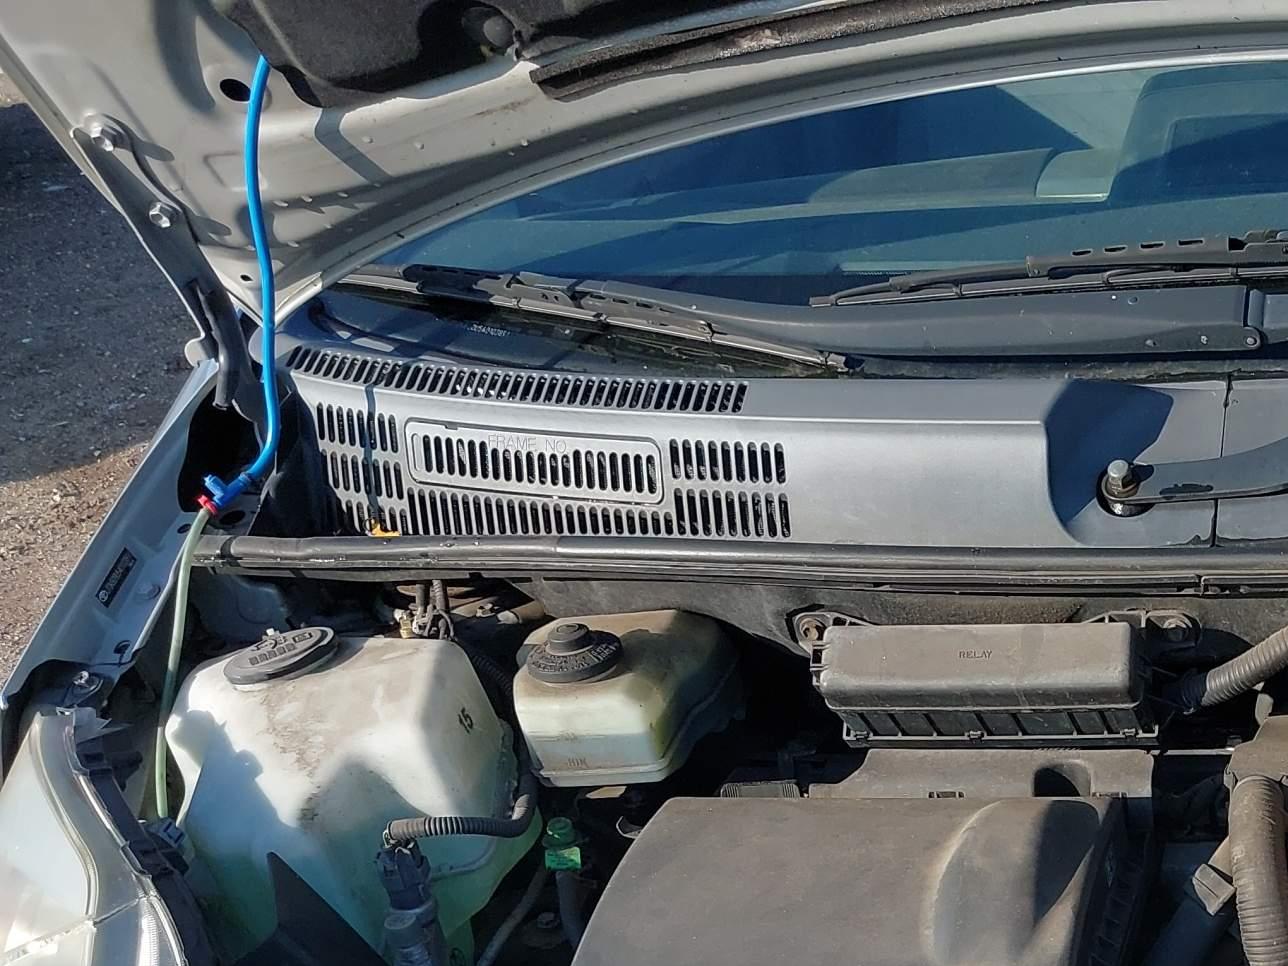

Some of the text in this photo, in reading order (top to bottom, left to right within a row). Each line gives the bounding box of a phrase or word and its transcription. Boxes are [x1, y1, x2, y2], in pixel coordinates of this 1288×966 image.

[488, 434, 537, 452] FRAME
[958, 650, 993, 659] RELAY
[457, 707, 474, 734] 15
